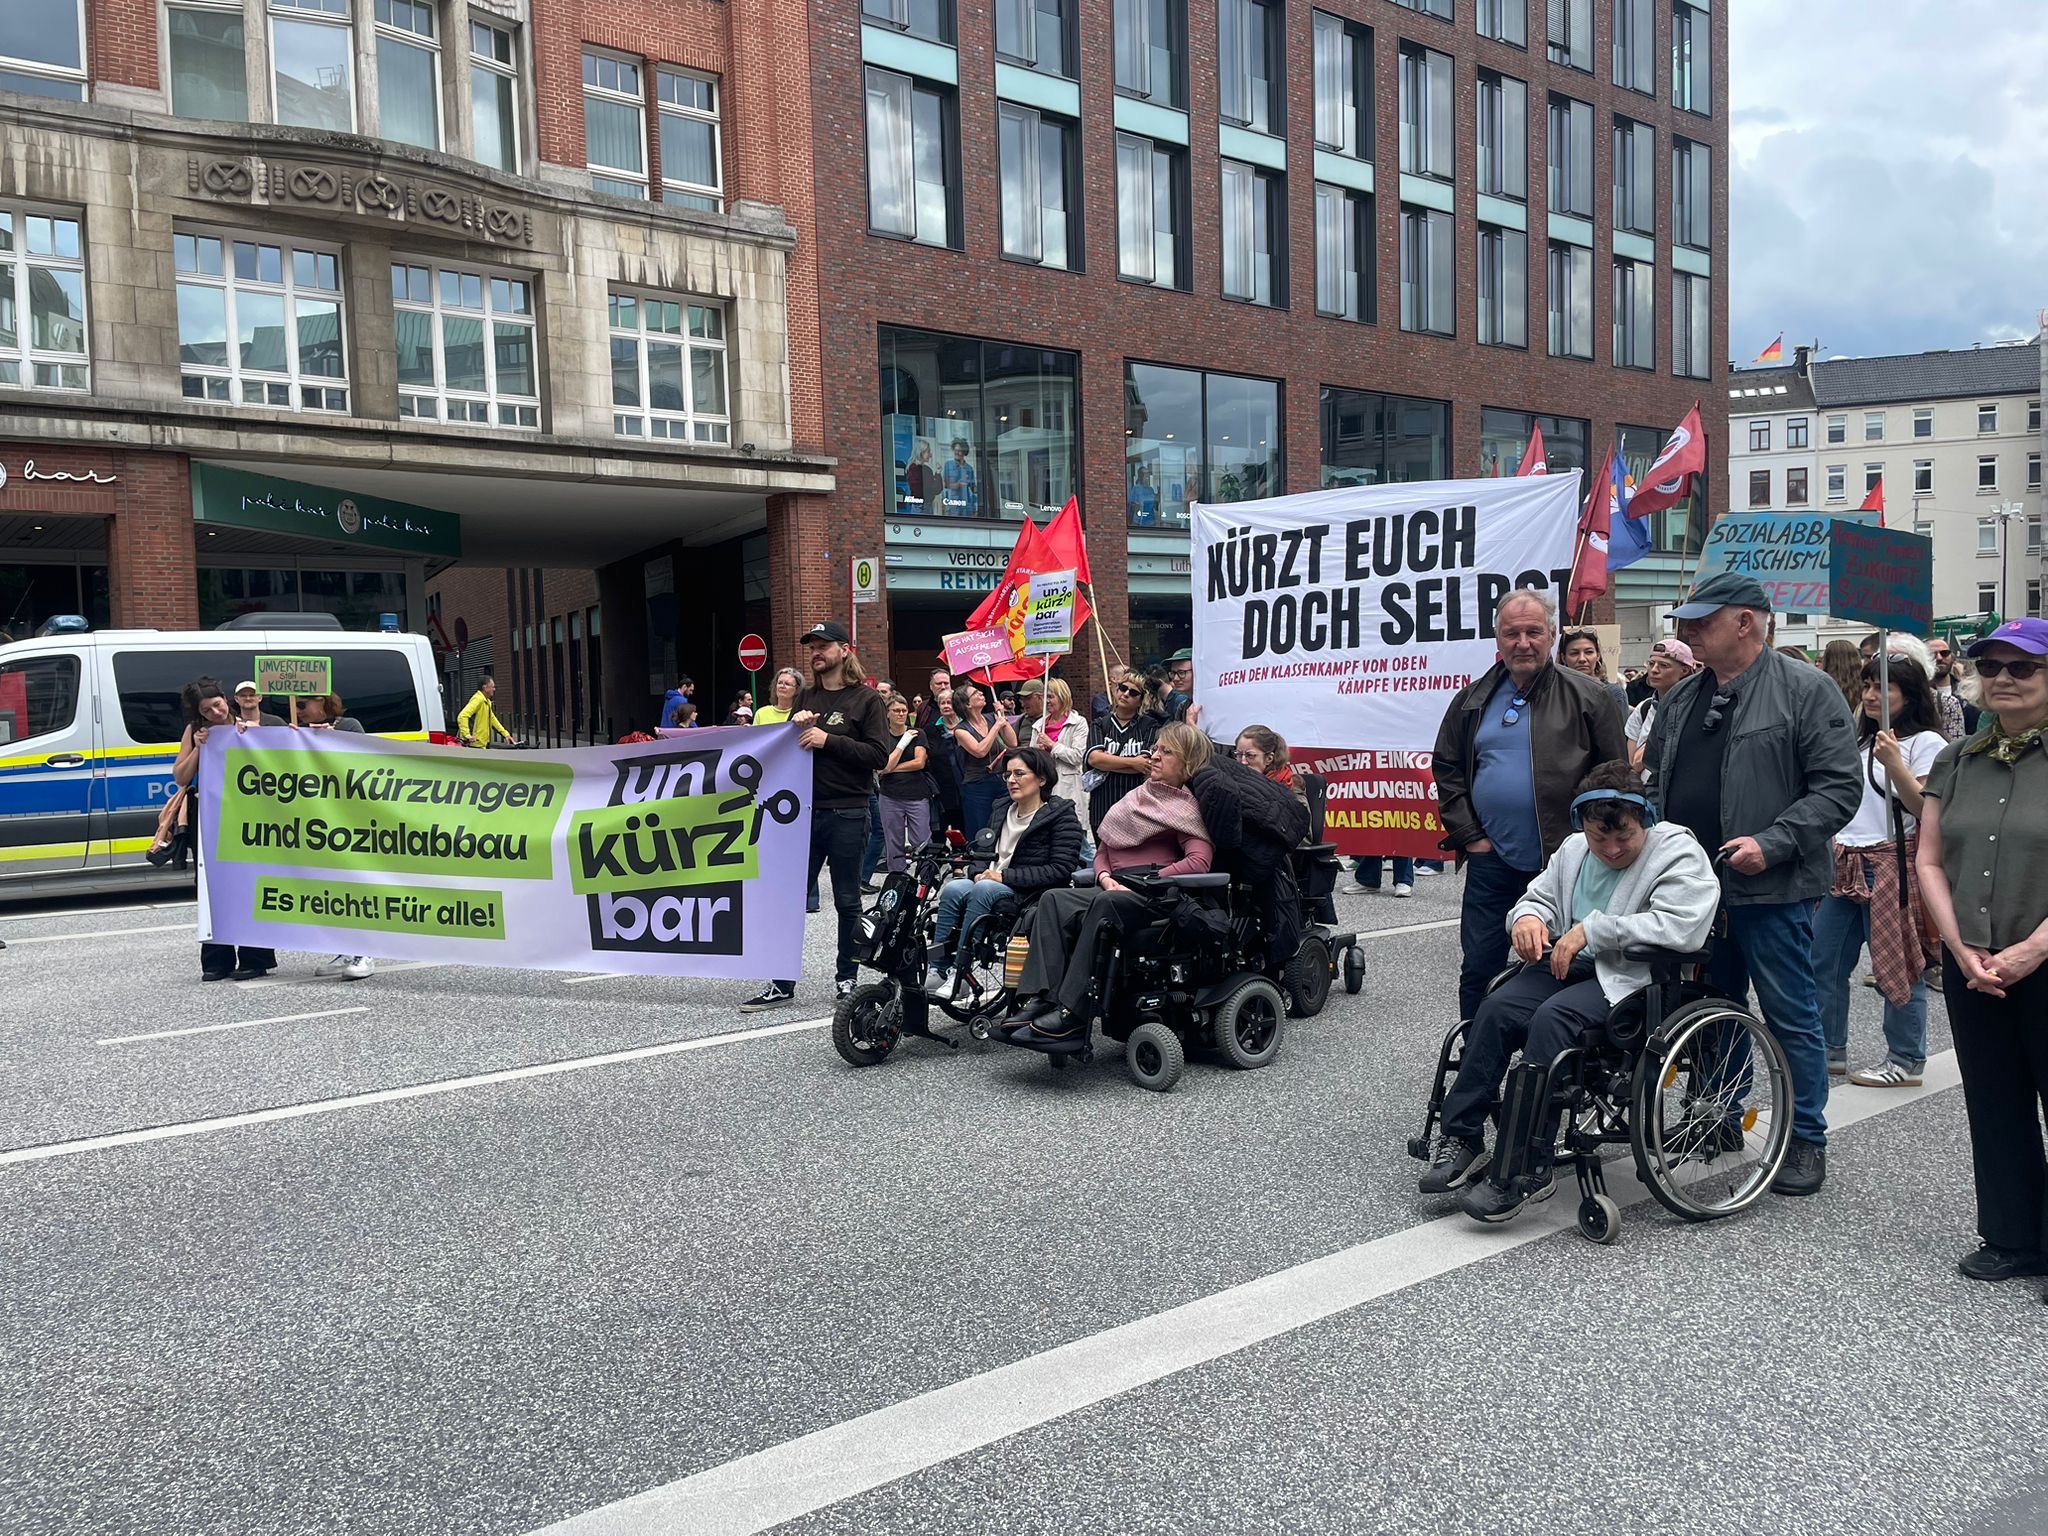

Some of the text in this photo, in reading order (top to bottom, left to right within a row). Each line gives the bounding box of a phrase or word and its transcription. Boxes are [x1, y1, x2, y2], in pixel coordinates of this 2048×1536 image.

[24, 459, 117, 484] bar
[943, 498, 967, 507] Canon
[1040, 504, 1063, 513] Lenovo
[1176, 512, 1191, 520] BOSC
[1207, 506, 1476, 602] KÜRZT EUCH
[1170, 559, 1191, 572] Luth
[1043, 587, 1059, 598] un
[1036, 597, 1063, 611] kürz
[1242, 586, 1360, 660] DOCH
[949, 638, 961, 648] ES
[961, 634, 975, 644] HAT
[258, 659, 327, 672] UMVERTEILEN
[1218, 655, 1428, 687] GEGEN DEN KLASSENKAMPF VON OBEN
[1337, 674, 1472, 695] KÄMPFE VERBINDEN
[1314, 752, 1371, 774] MEHR
[1376, 750, 1433, 770] EINKO
[147, 781, 181, 800] PO
[237, 764, 555, 813] Gegen Kürzungen
[621, 761, 706, 805] un
[1325, 781, 1425, 799] OHNUNGEN
[1324, 810, 1421, 831] NALISMUS
[1424, 812, 1438, 832] &
[241, 817, 528, 861] und Sozialabbau
[579, 813, 745, 879] kürz
[261, 887, 496, 928] Es reicht! Für alle!
[597, 892, 730, 943] bar
